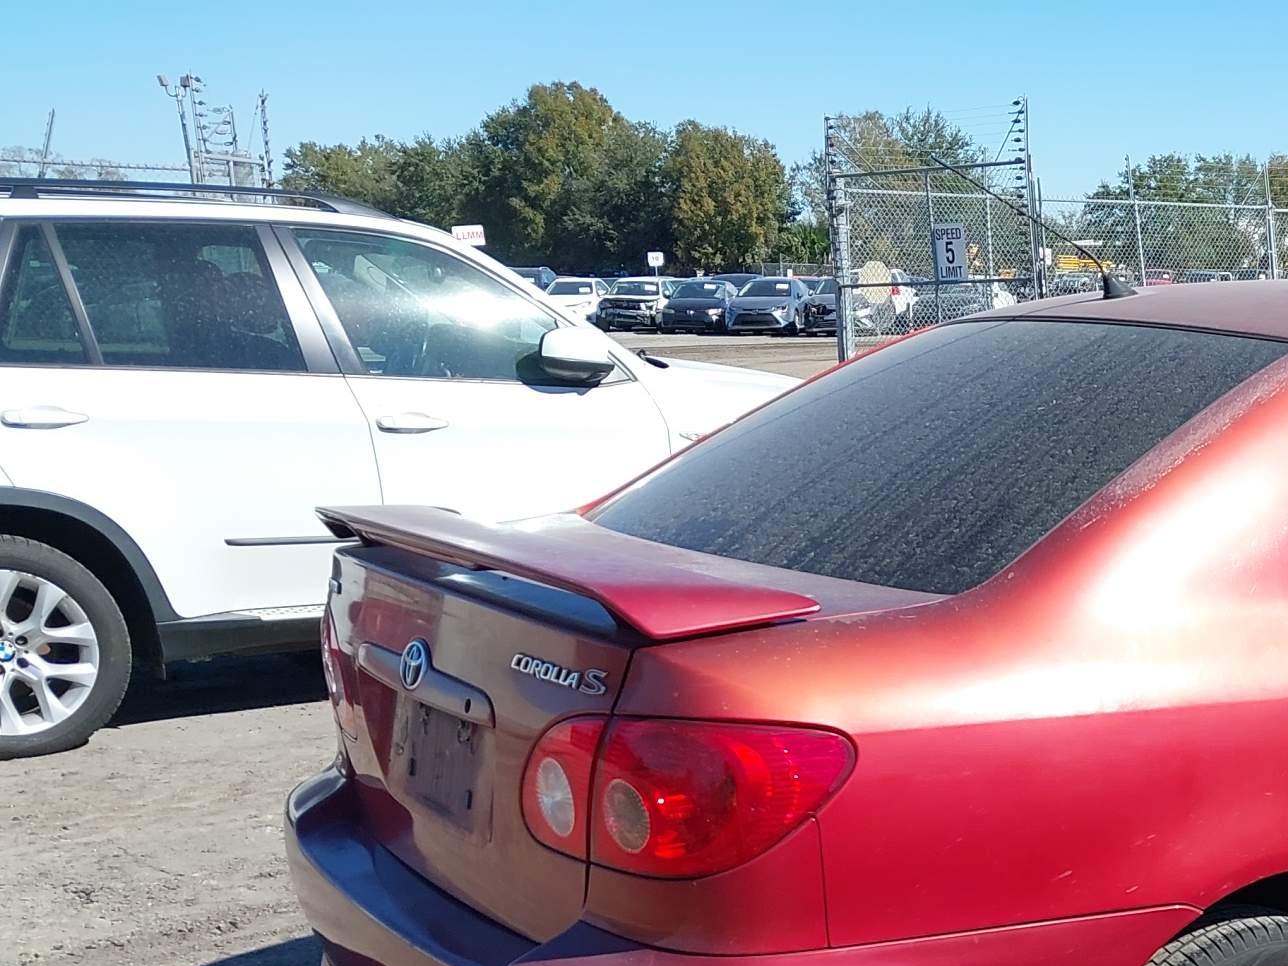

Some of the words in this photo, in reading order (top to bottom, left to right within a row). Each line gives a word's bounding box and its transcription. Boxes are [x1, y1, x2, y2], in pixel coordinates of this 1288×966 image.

[935, 227, 962, 241] SPEED
[945, 241, 955, 265] 5
[940, 265, 963, 279] LIMIT
[511, 653, 580, 689] COROLLA
[579, 668, 609, 695] S
